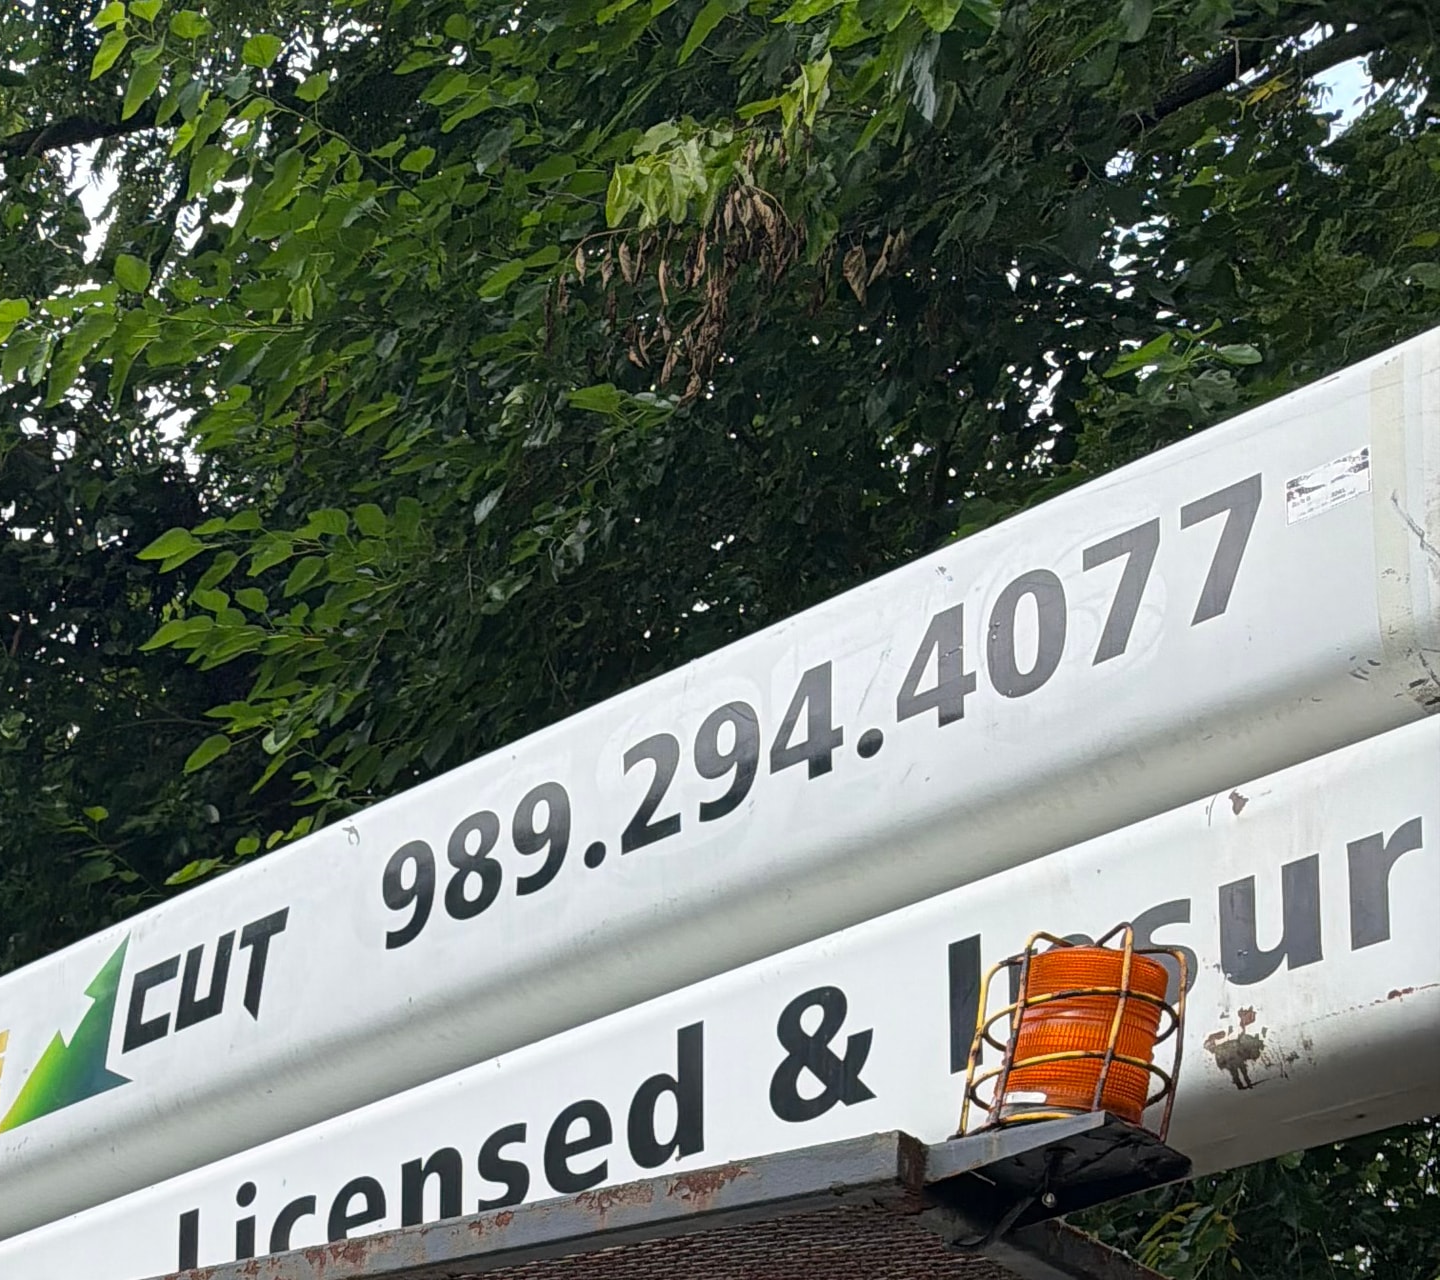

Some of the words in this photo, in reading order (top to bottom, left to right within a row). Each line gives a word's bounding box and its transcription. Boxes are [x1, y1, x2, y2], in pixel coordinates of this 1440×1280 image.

[122, 907, 289, 1054] CUT
[382, 473, 1263, 949] 989.294.4077
[768, 984, 875, 1122] &
[947, 816, 1423, 1072] Isur
